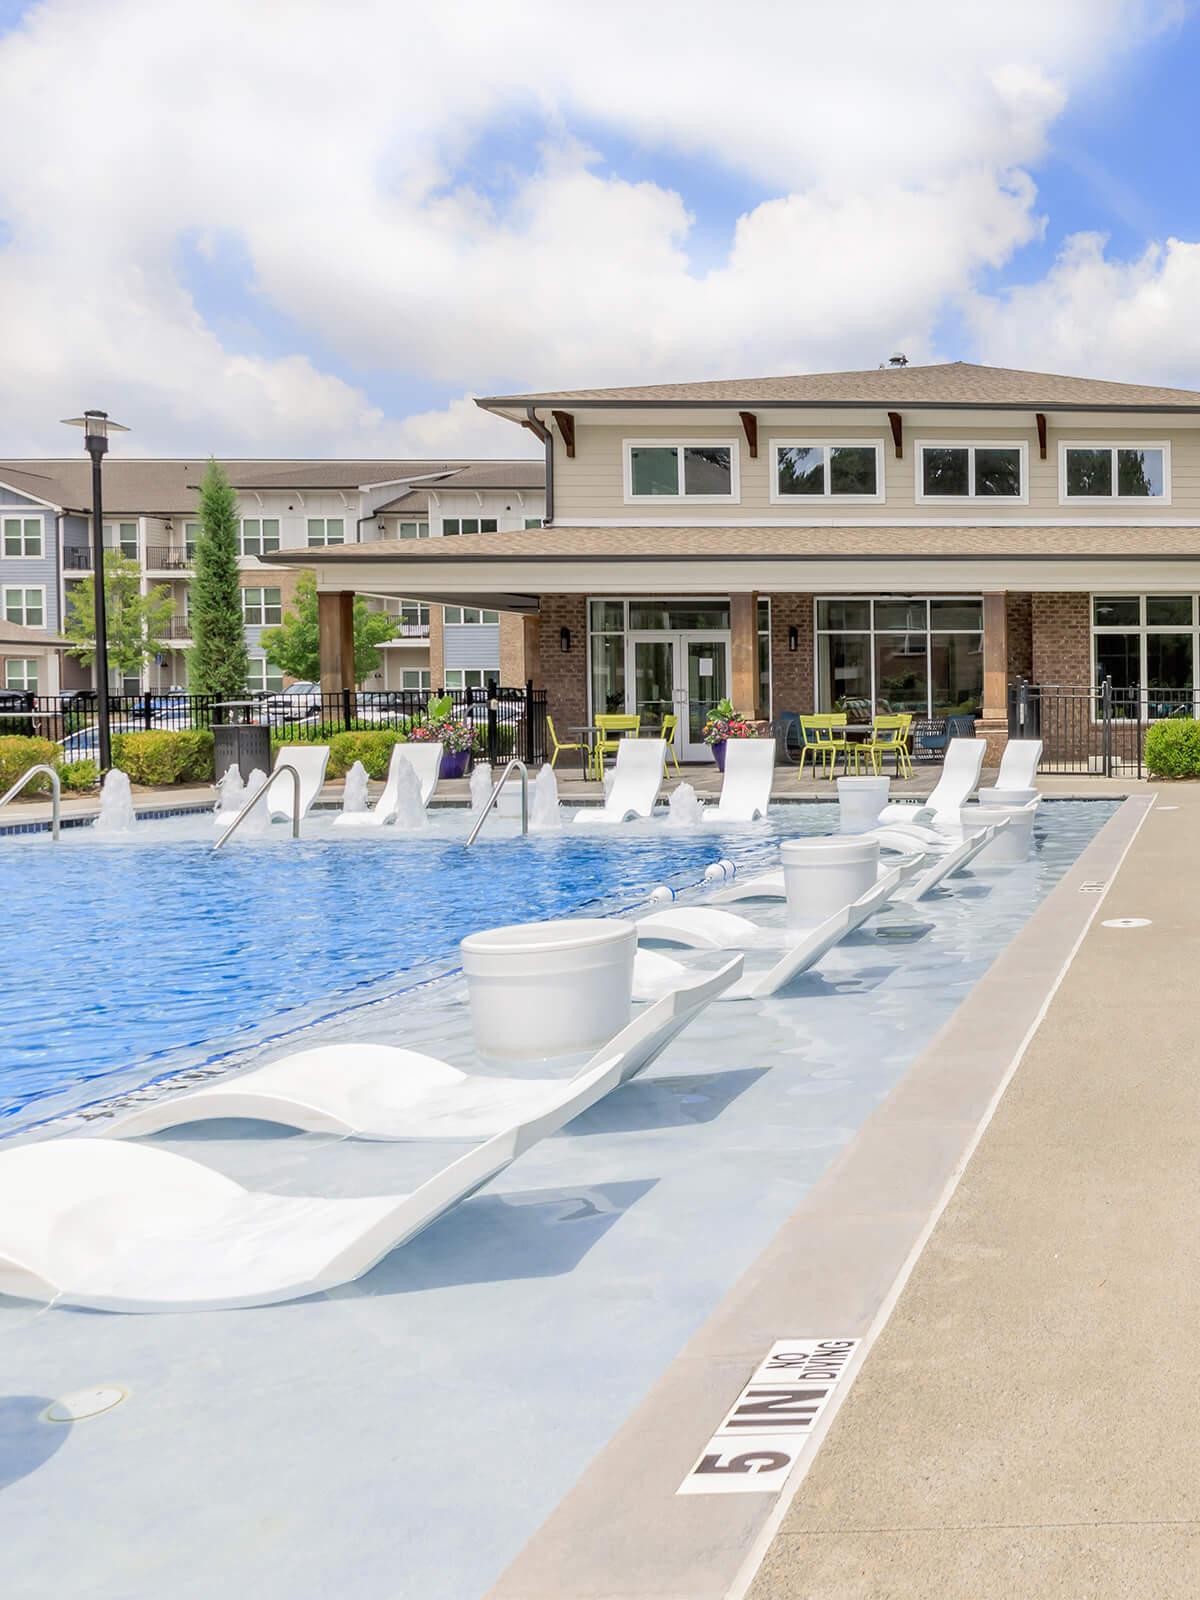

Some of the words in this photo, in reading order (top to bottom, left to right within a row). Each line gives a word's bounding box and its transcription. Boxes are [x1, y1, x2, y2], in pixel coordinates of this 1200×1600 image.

[764, 1352, 810, 1370] NO
[797, 1340, 856, 1380] DIVING
[725, 1389, 829, 1428] IN
[693, 1451, 792, 1474] 5
